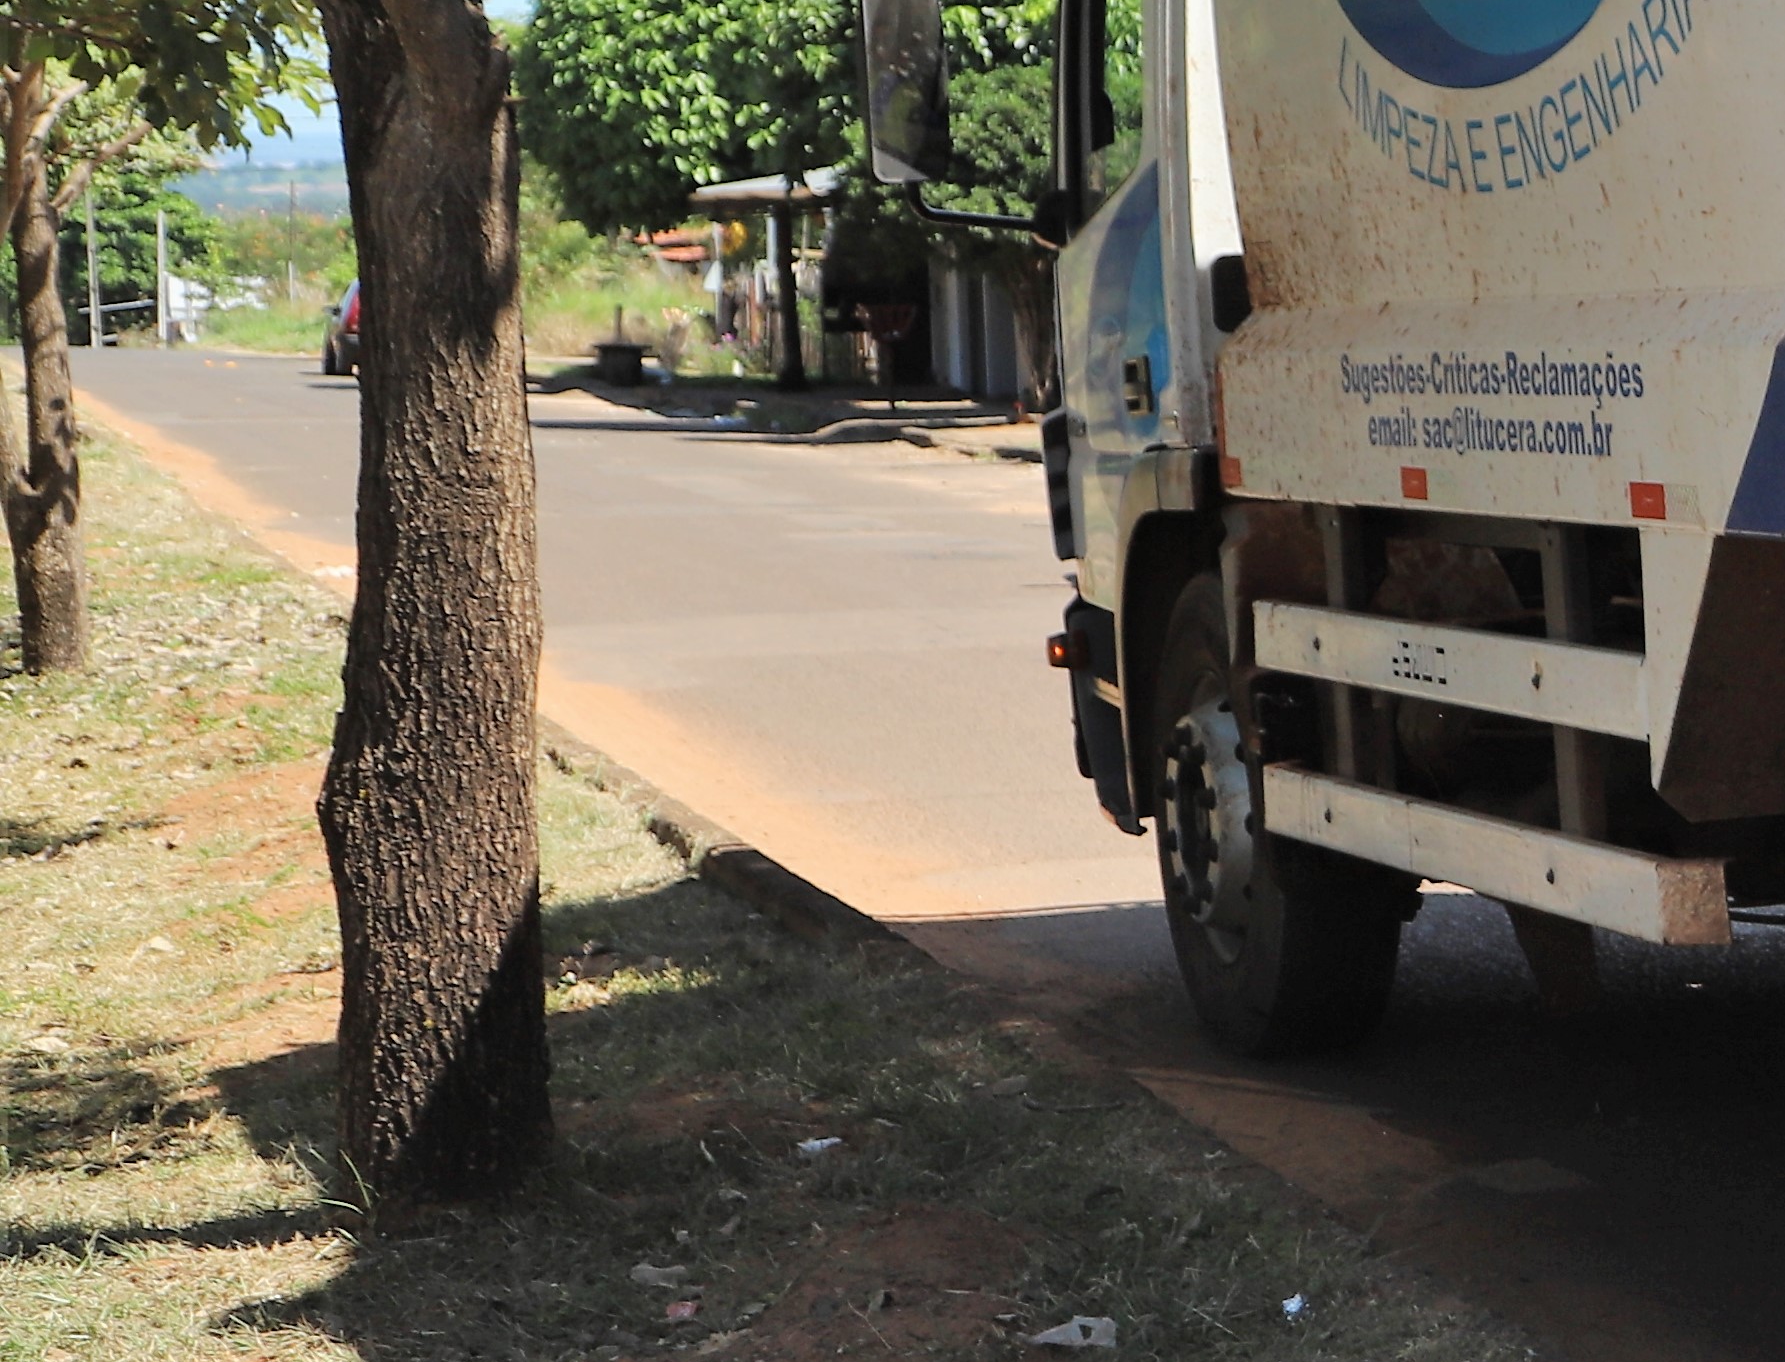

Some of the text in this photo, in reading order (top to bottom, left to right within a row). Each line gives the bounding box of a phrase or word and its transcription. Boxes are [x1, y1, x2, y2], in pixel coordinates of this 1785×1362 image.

[1338, 37, 1468, 194] LIMPEZA
[1467, 119, 1493, 194] E
[1368, 406, 1614, 457] email: sac@litucera.com.br
